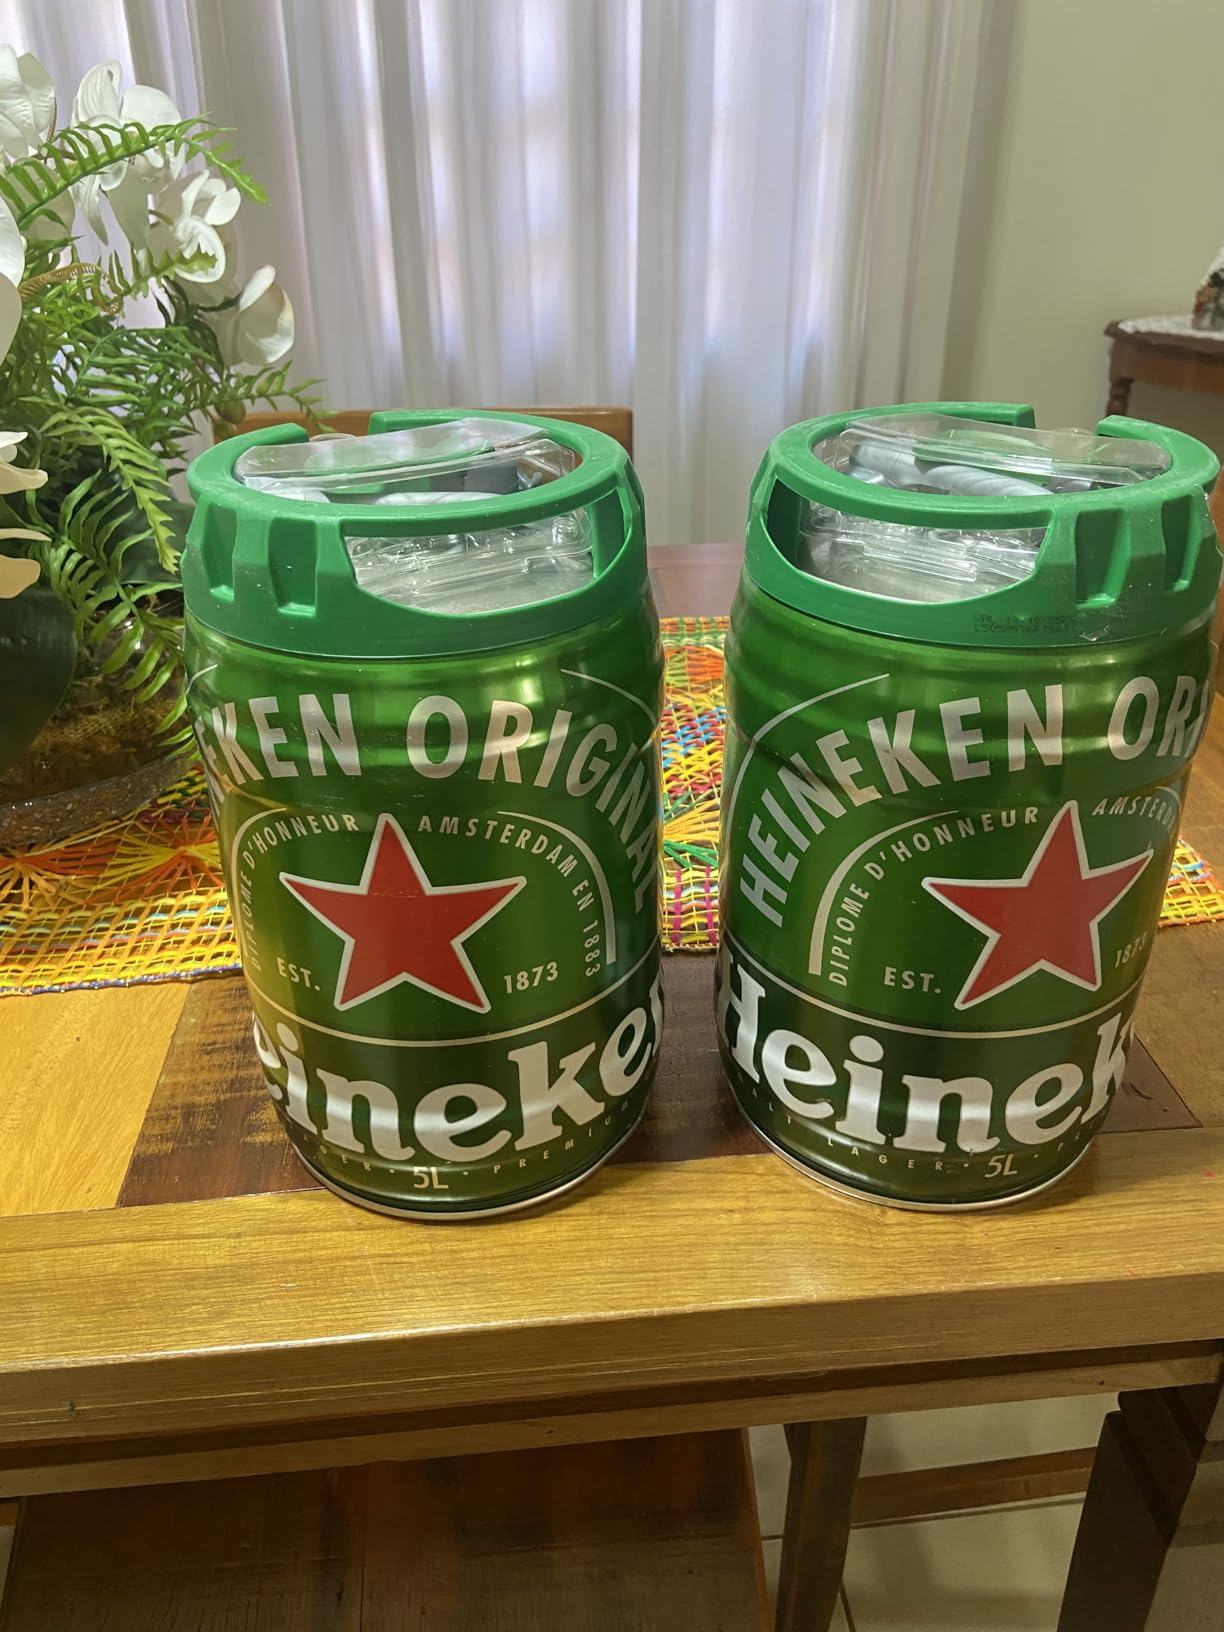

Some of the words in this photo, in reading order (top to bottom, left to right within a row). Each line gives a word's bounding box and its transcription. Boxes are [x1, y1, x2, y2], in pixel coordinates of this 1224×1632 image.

[739, 683, 1064, 928] HEINEKEN
[242, 813, 360, 870] D'HONNEUR
[417, 814, 578, 878] AMSTERDAM
[571, 878, 595, 912] EN
[828, 882, 870, 987] DIPLOME
[863, 806, 1039, 881] D'HONNEUR
[582, 919, 601, 977] 1883
[276, 956, 321, 991] EST.
[503, 961, 559, 994] 1873
[883, 965, 942, 995] EST.
[413, 1166, 449, 1190] 5L
[827, 1136, 944, 1172] LAGER
[983, 1153, 1019, 1179] 5L
